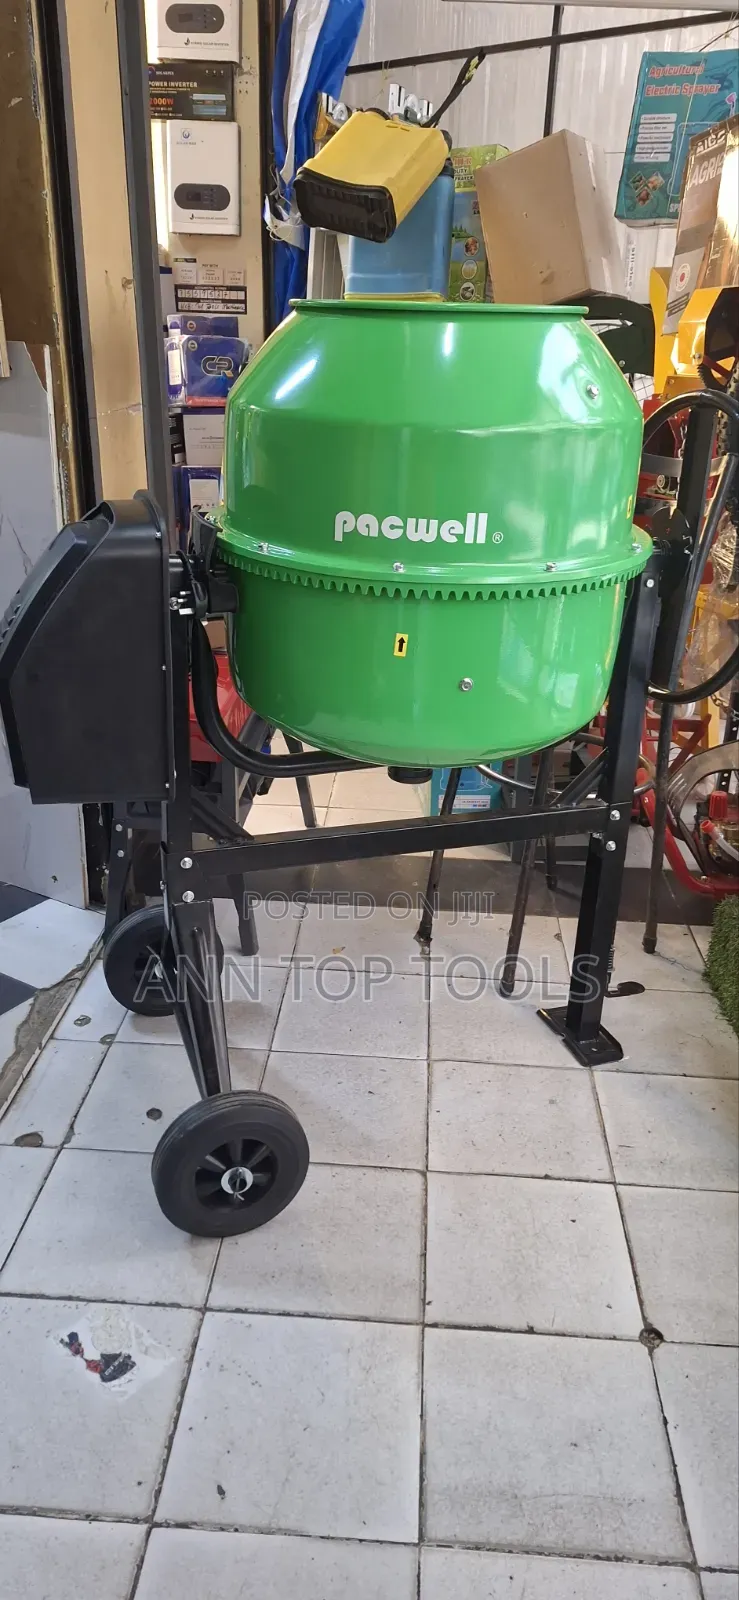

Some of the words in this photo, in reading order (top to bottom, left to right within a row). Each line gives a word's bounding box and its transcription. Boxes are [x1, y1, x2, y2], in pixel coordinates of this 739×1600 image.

[648, 63, 705, 79] Agricultural
[645, 83, 681, 97] Electric
[681, 83, 722, 97] Sprayer
[334, 510, 489, 544] pacwell
